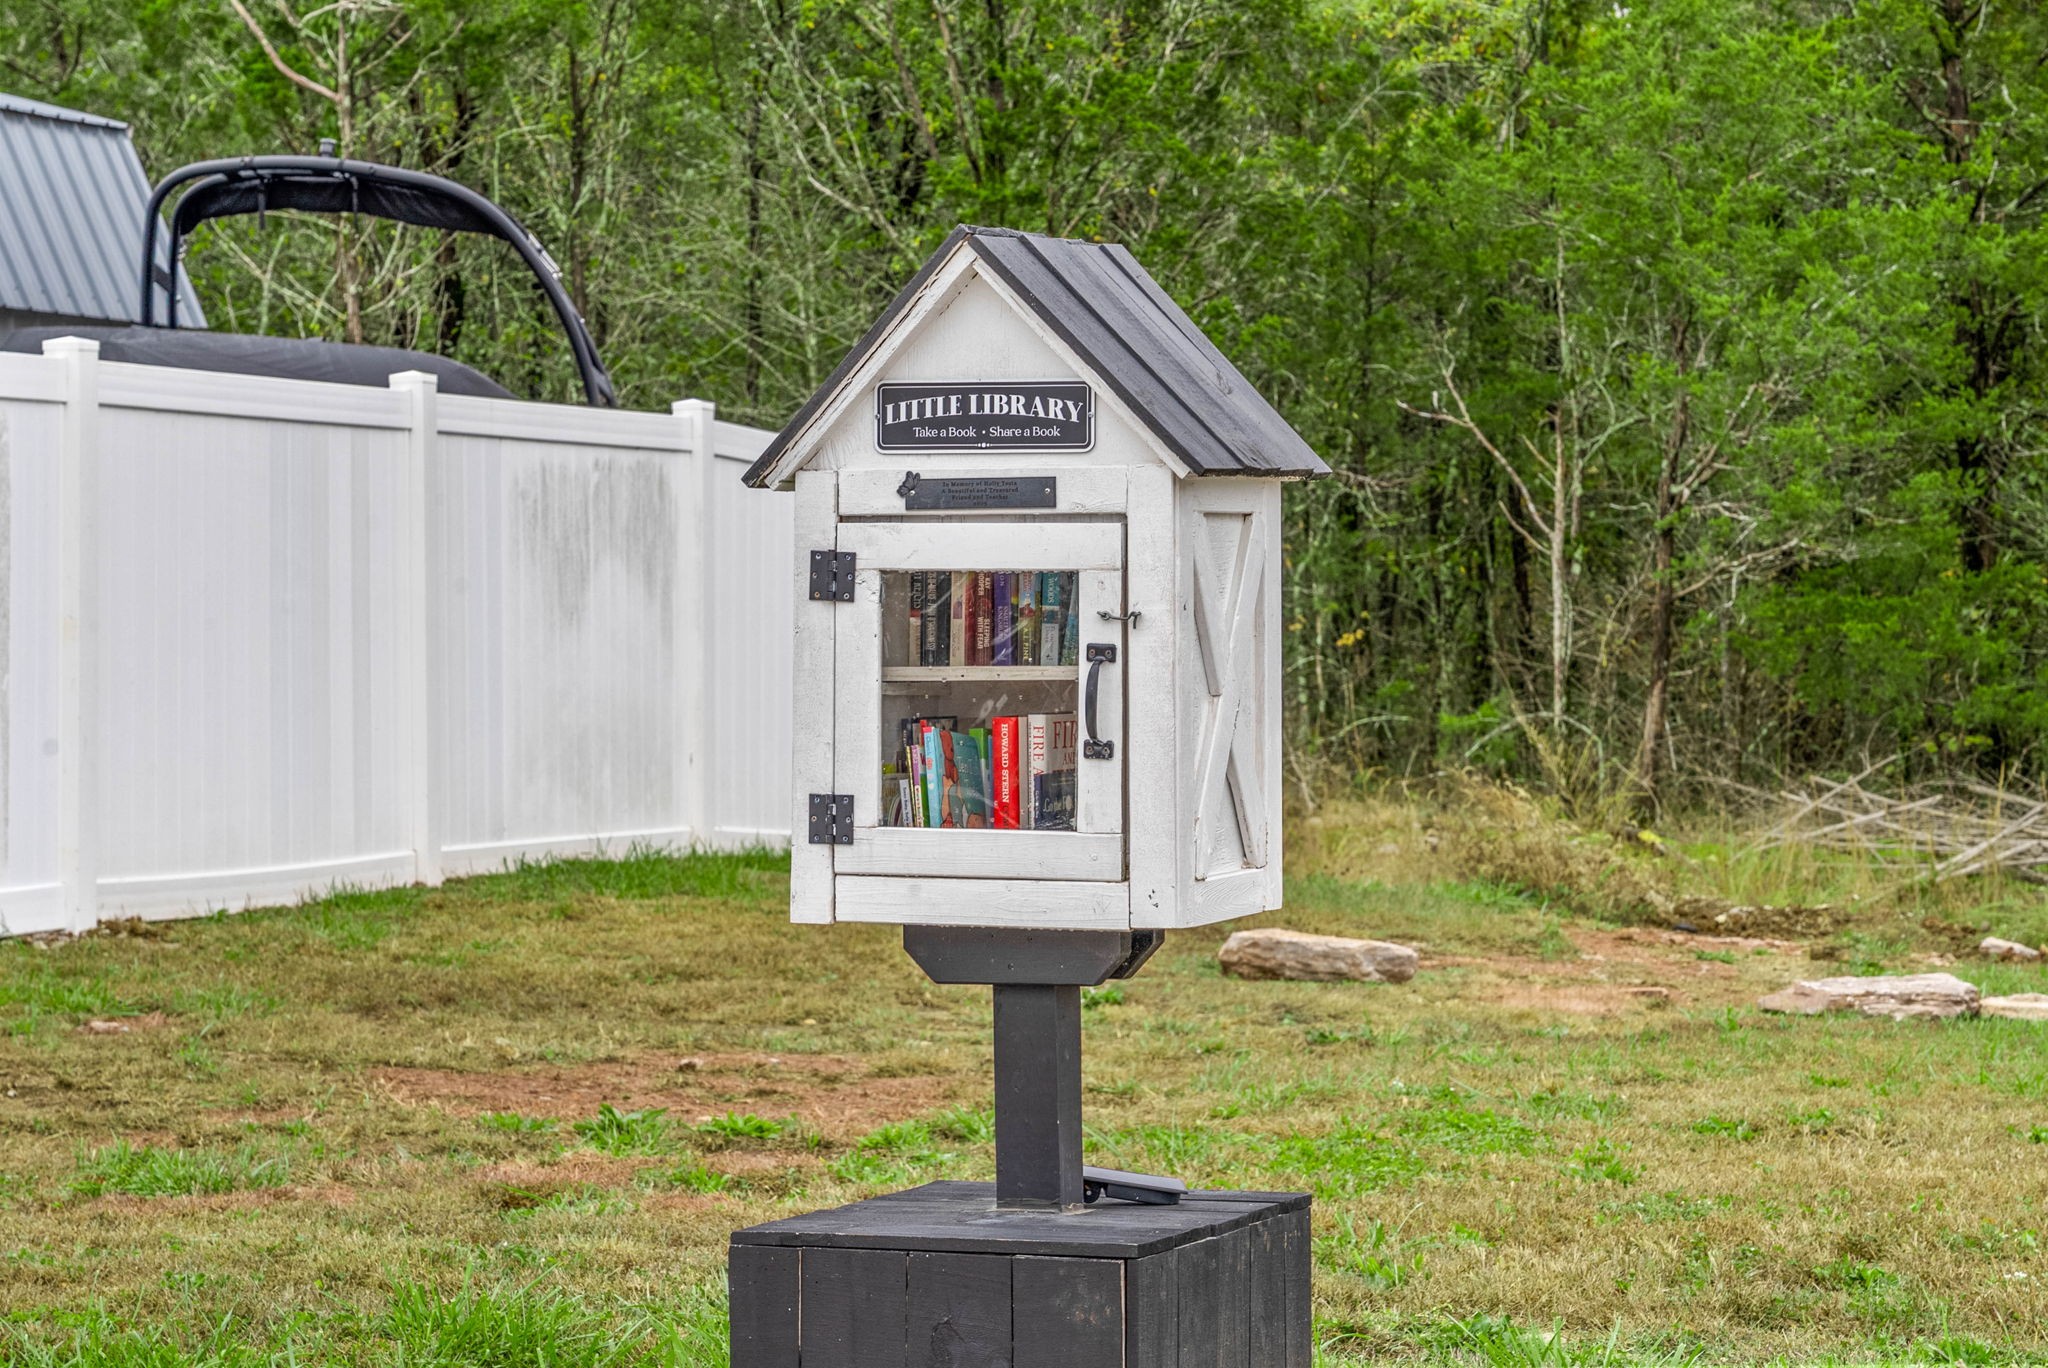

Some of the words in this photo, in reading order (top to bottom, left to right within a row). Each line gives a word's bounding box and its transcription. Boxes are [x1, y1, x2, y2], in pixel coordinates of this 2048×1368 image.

[884, 394, 963, 426] LITTLE
[968, 393, 1084, 423] LIBRARY
[913, 427, 938, 438] Take
[939, 429, 947, 437] a
[948, 426, 977, 437] Book
[989, 426, 1021, 437] Share
[1023, 429, 1030, 437] a
[1032, 425, 1061, 437] Book
[1048, 577, 1056, 603] WOODS
[1001, 723, 1009, 768] HOWARD
[1033, 725, 1045, 762] FIRE
[1052, 721, 1077, 749] FIR
[1002, 769, 1010, 803] STERN
